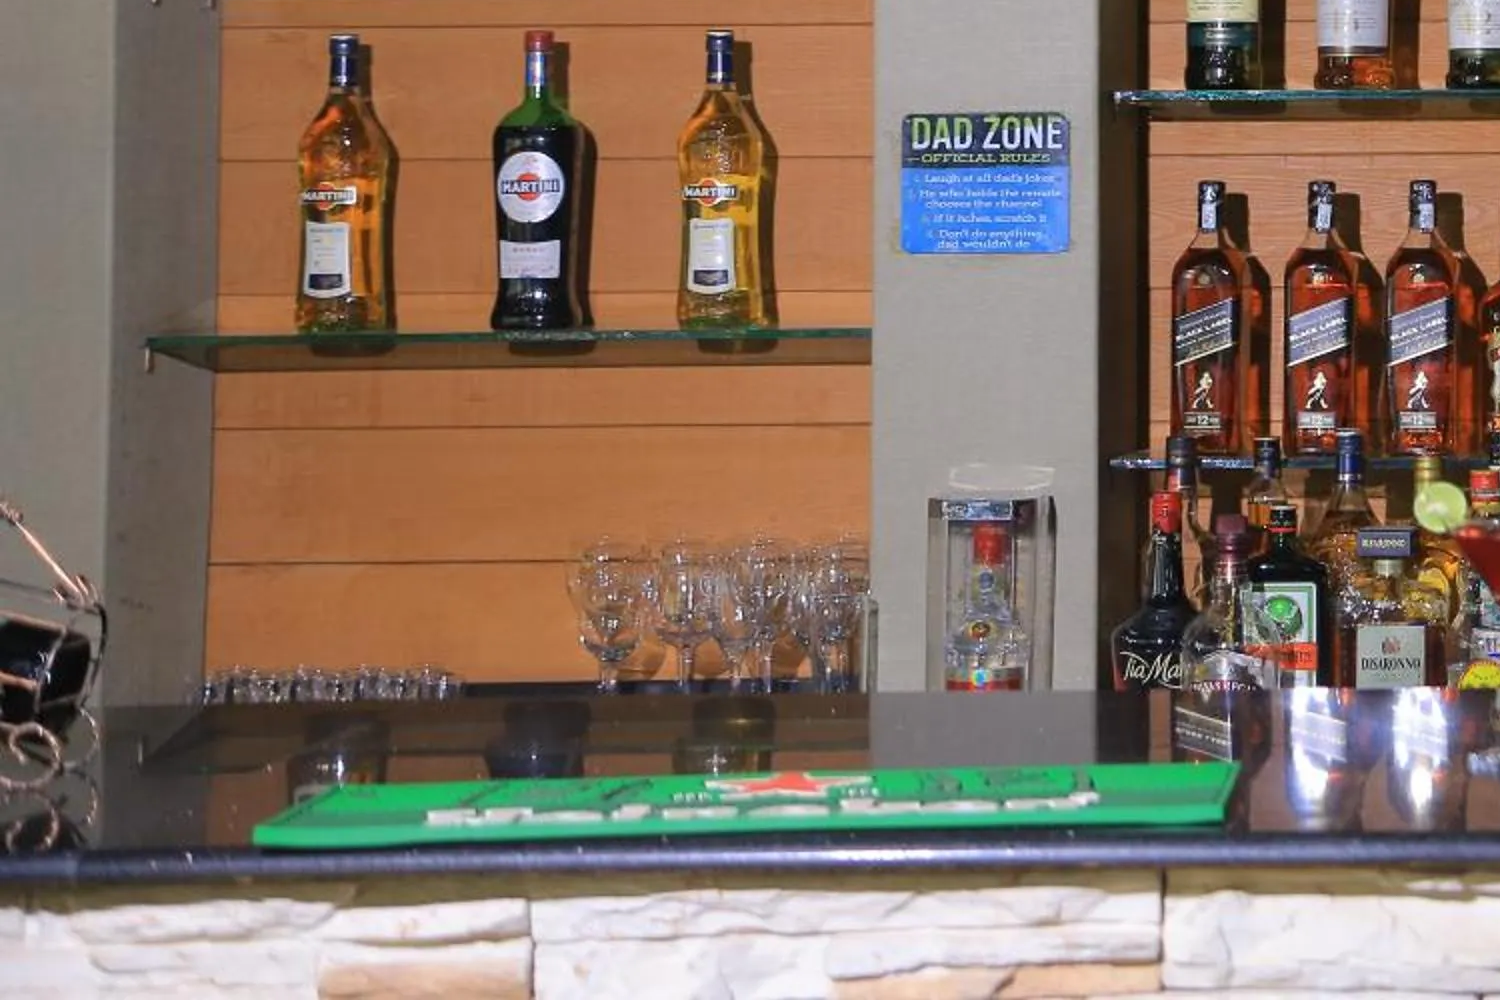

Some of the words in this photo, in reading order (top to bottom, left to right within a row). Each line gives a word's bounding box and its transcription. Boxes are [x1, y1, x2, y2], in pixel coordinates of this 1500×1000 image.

[911, 116, 974, 150] DAD
[981, 115, 1064, 150] ZONE
[921, 153, 997, 164] OFFICIAL
[1000, 153, 1052, 163] RULES
[501, 178, 560, 194] MARTINI
[684, 186, 736, 197] MARTINI
[301, 189, 354, 204] MARTINI
[1205, 317, 1233, 331] LABEL
[1319, 316, 1347, 330] LABEL
[1420, 316, 1447, 330] LABEL
[1197, 415, 1209, 425] 12
[1361, 655, 1421, 672] DISARONNO
